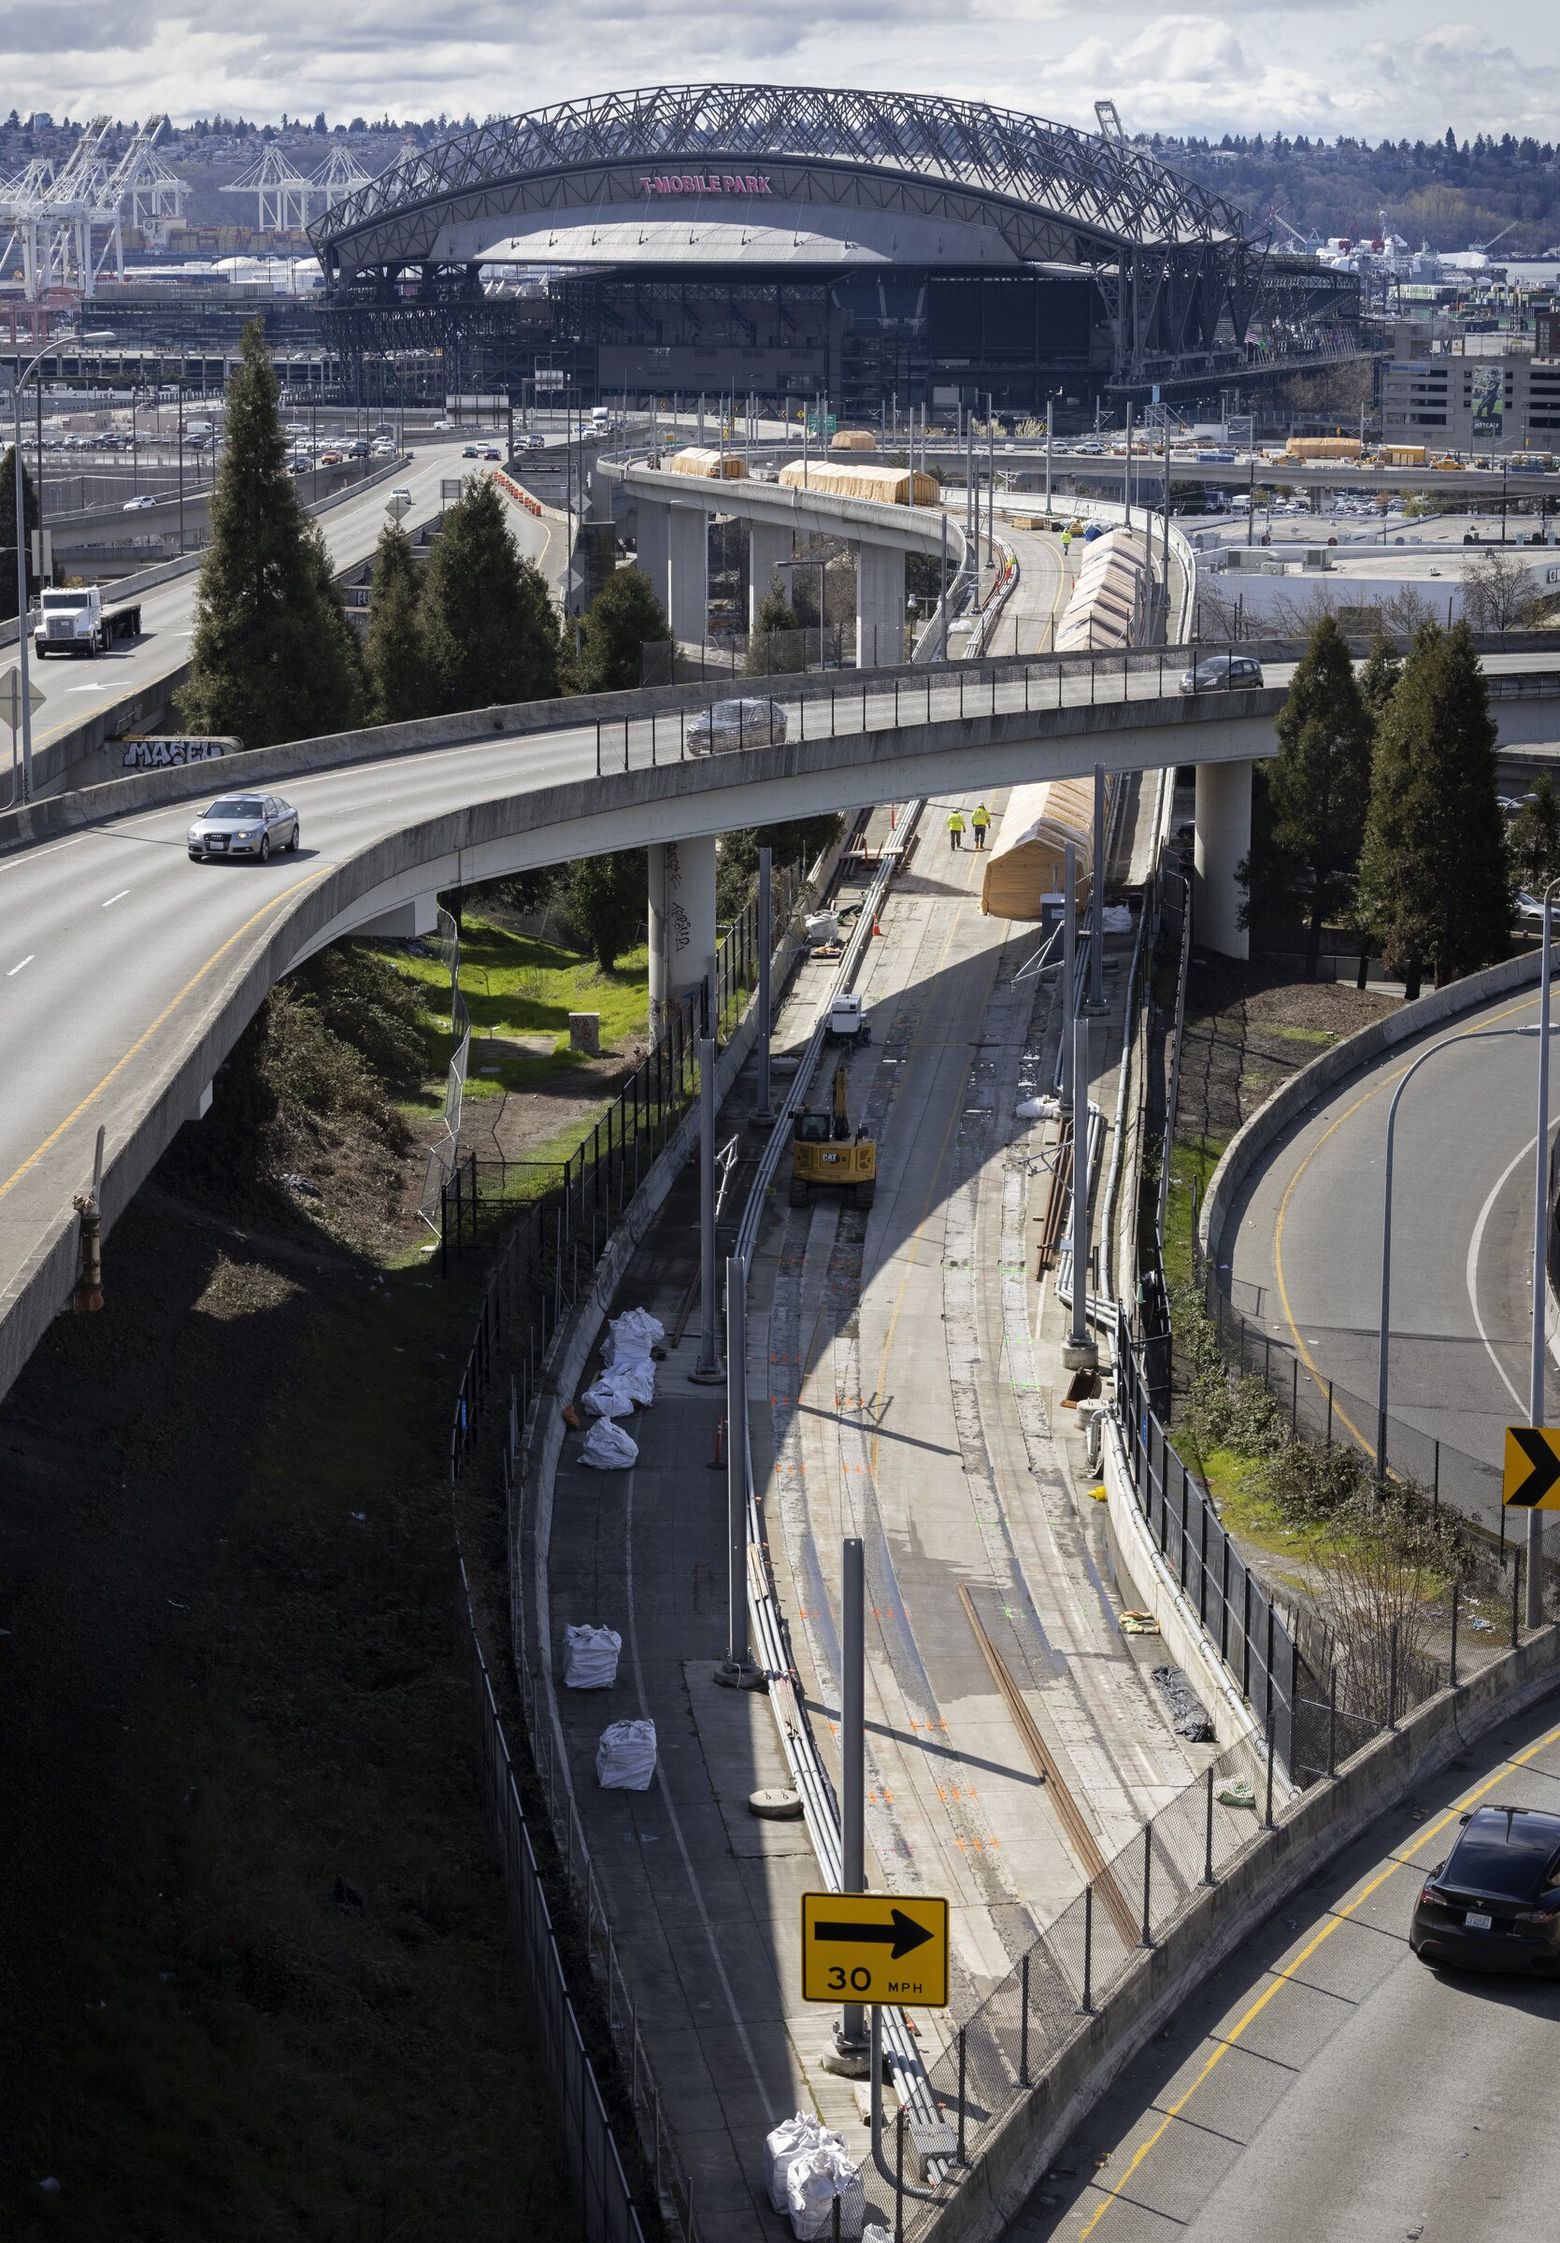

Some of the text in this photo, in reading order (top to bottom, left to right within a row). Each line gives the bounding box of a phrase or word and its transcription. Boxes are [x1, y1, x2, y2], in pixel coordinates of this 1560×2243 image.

[640, 175, 772, 194] T-MOBILE PARK
[822, 1153, 838, 1161] CAT
[827, 1966, 923, 1994] 30 MPH
